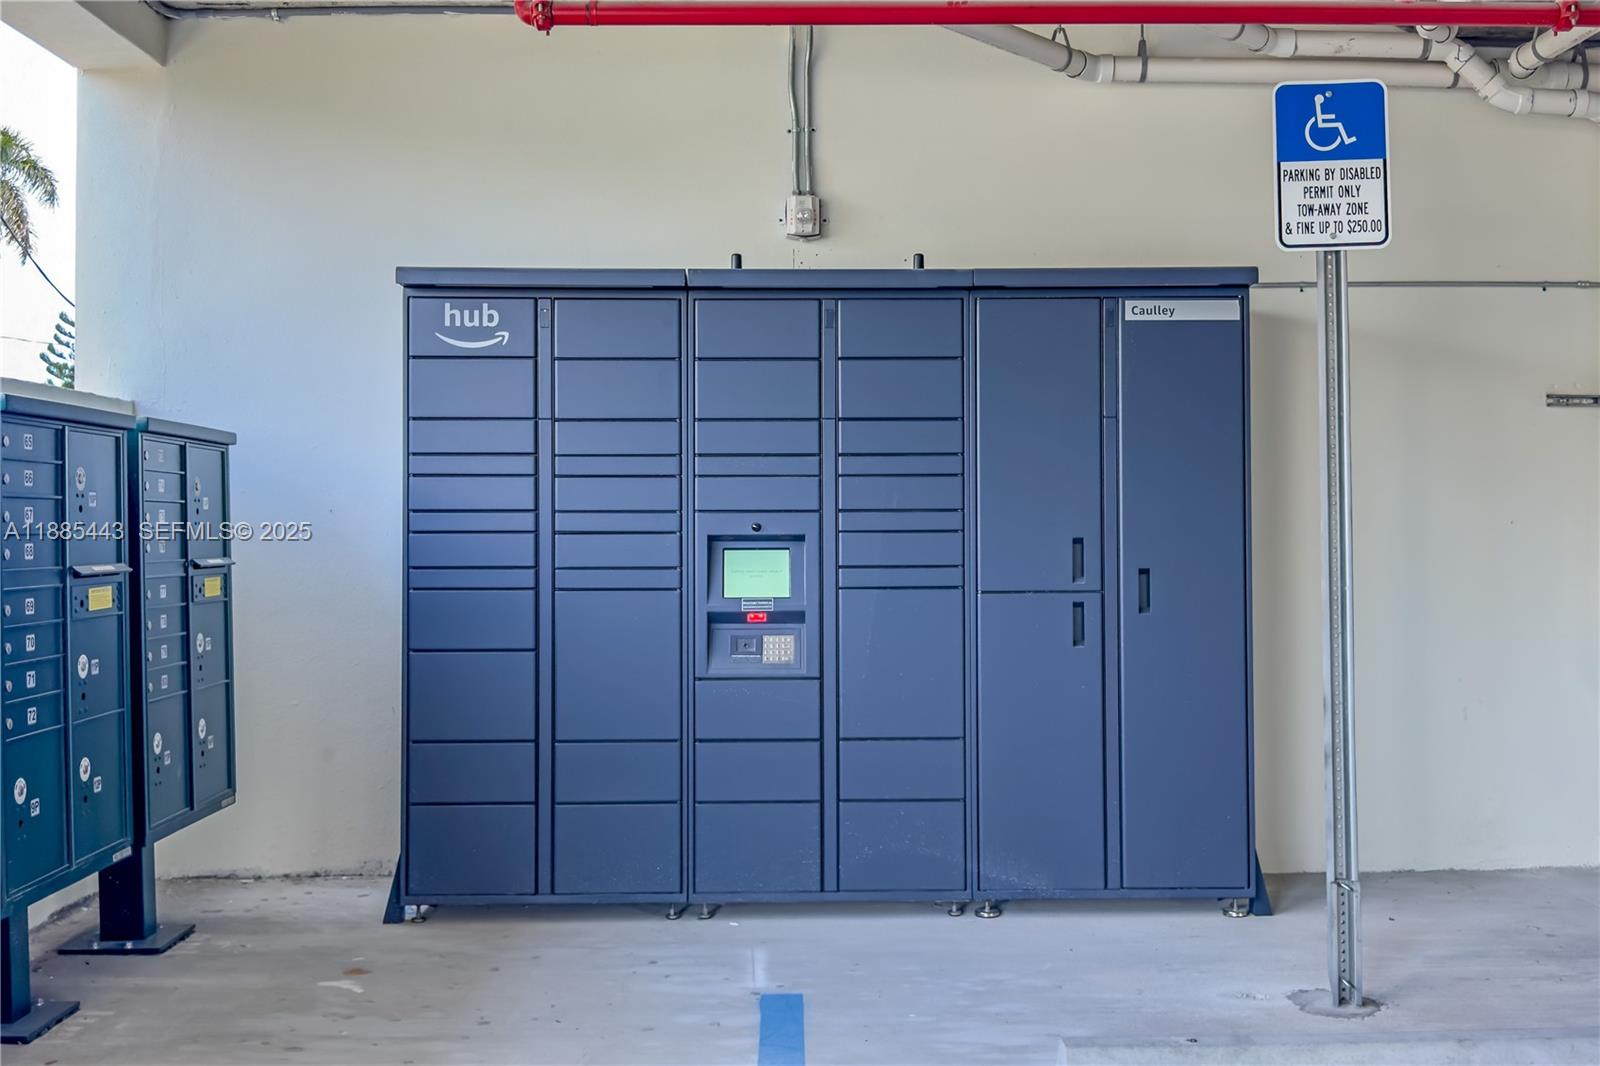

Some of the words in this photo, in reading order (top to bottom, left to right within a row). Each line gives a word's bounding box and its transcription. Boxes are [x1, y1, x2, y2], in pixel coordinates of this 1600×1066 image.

[1283, 168, 1321, 182] PARKING
[1325, 168, 1336, 181] BY
[1340, 166, 1381, 181] DISABLED
[1303, 185, 1334, 199] PERMIT
[1338, 184, 1361, 198] ONLY
[1297, 203, 1342, 217] TOW-AWAY
[1346, 202, 1369, 215] ZONE
[1285, 223, 1293, 235] &
[1296, 221, 1315, 235] FINE
[1319, 221, 1331, 234] UP
[1332, 220, 1343, 234] TO
[1347, 219, 1382, 234] $250.00
[444, 302, 500, 327] hub
[1131, 305, 1176, 318] Caulley
[24, 436, 33, 448] 65
[24, 472, 33, 484] 66
[26, 600, 34, 612] 69
[26, 636, 35, 649] 70
[27, 673, 36, 686] 71
[27, 709, 37, 722] 72
[30, 800, 39, 814] 9P
